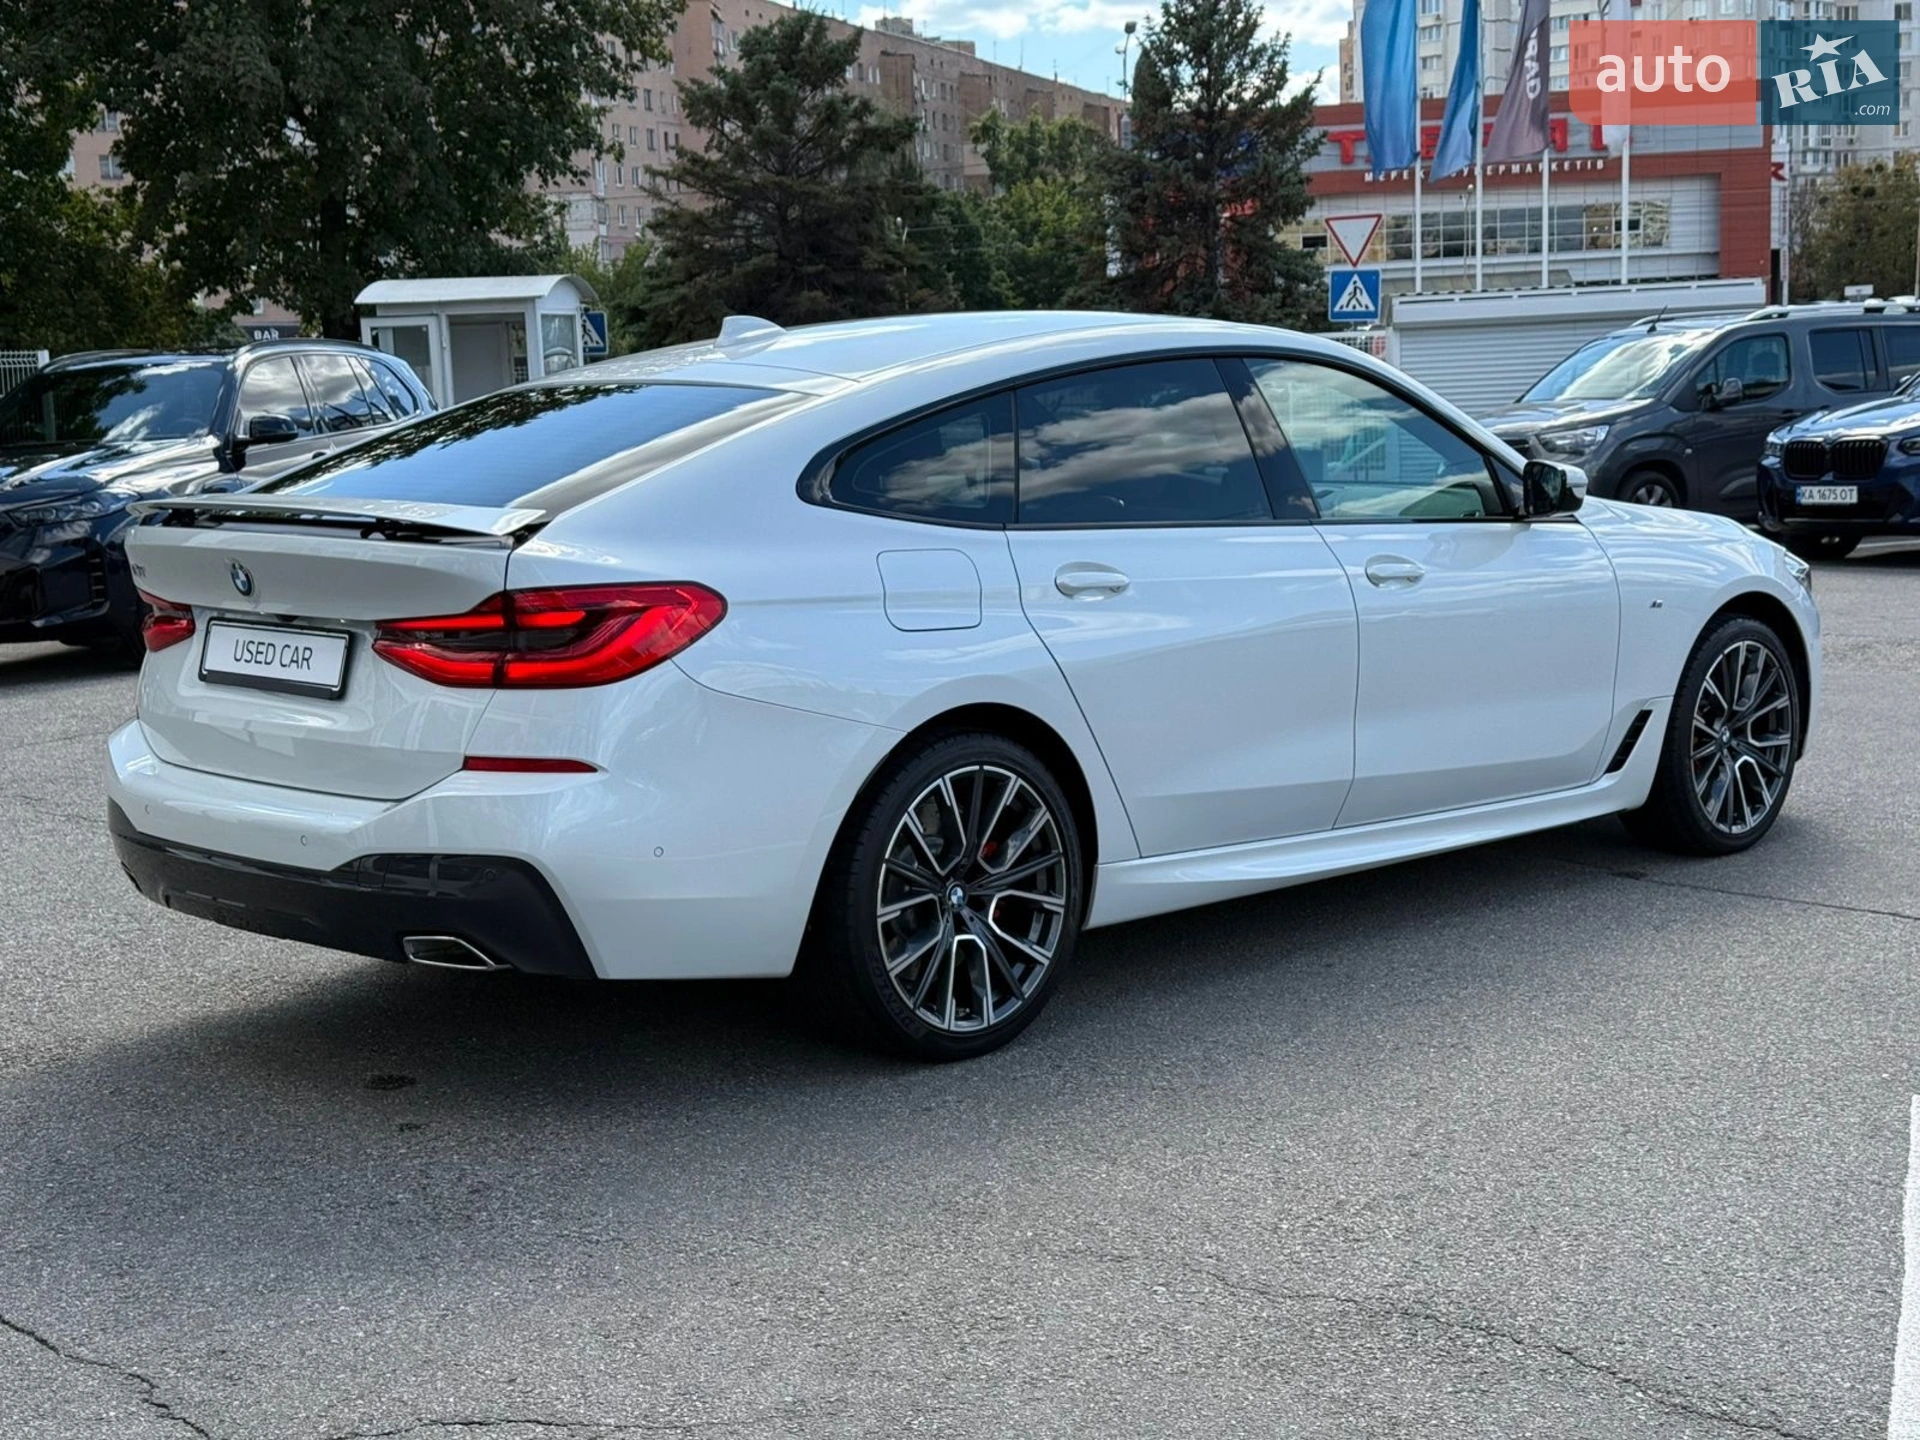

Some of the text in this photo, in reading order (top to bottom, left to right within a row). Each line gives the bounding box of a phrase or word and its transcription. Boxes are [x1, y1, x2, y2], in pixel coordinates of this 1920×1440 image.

[253, 329, 279, 340] BAR
[1816, 488, 1838, 500] 1675
[1839, 488, 1855, 500] OT
[233, 639, 313, 670] USED CAR
